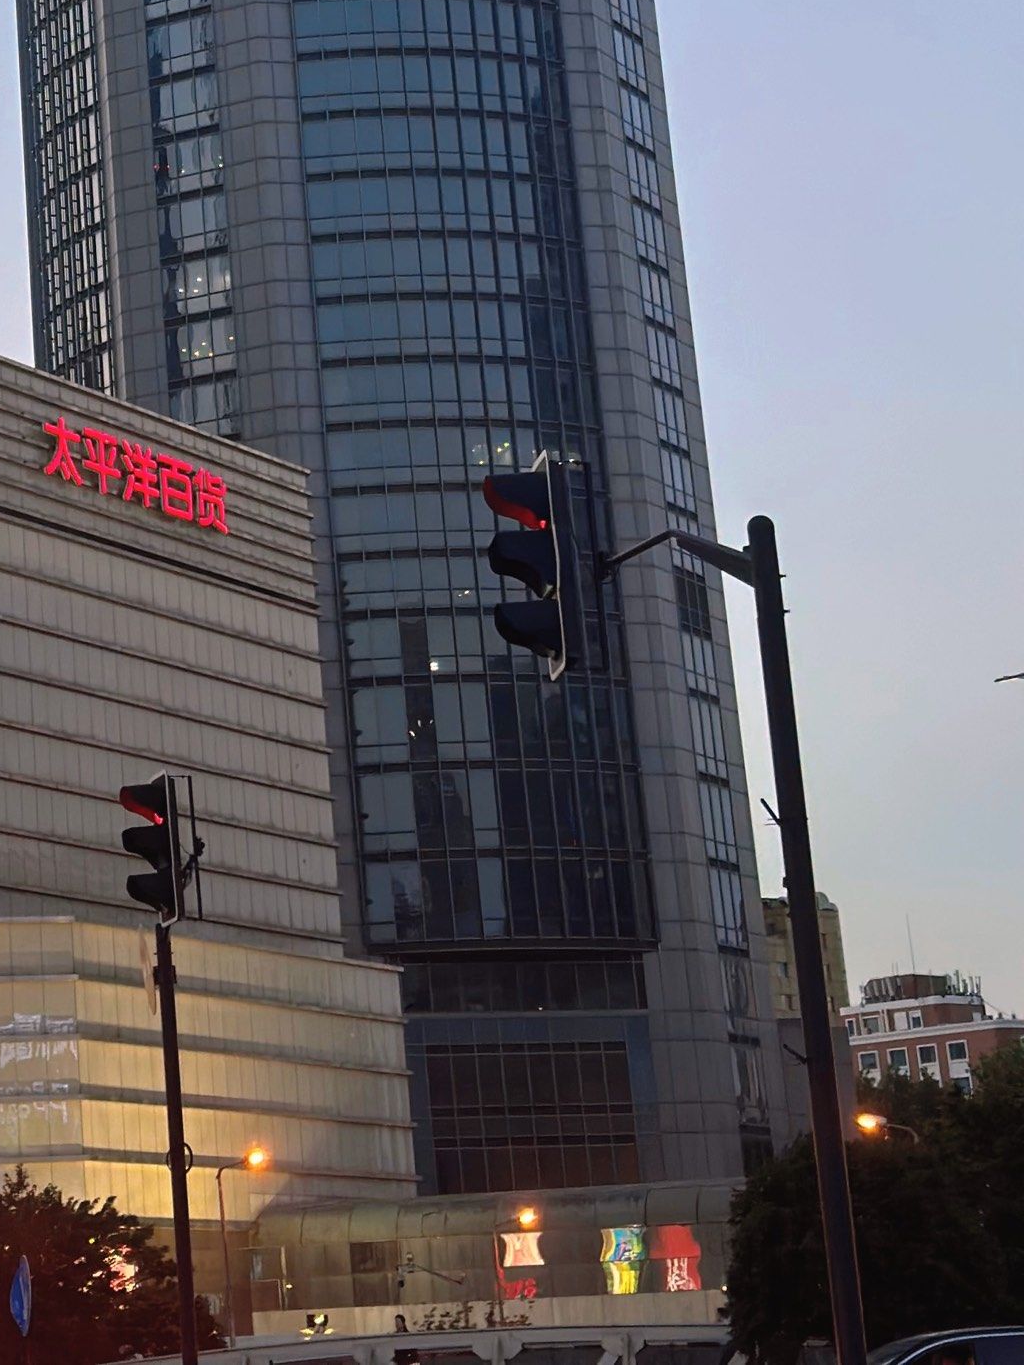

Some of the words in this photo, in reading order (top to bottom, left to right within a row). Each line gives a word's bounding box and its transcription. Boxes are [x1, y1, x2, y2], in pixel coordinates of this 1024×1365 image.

[43, 417, 229, 535] 太平洋百货
